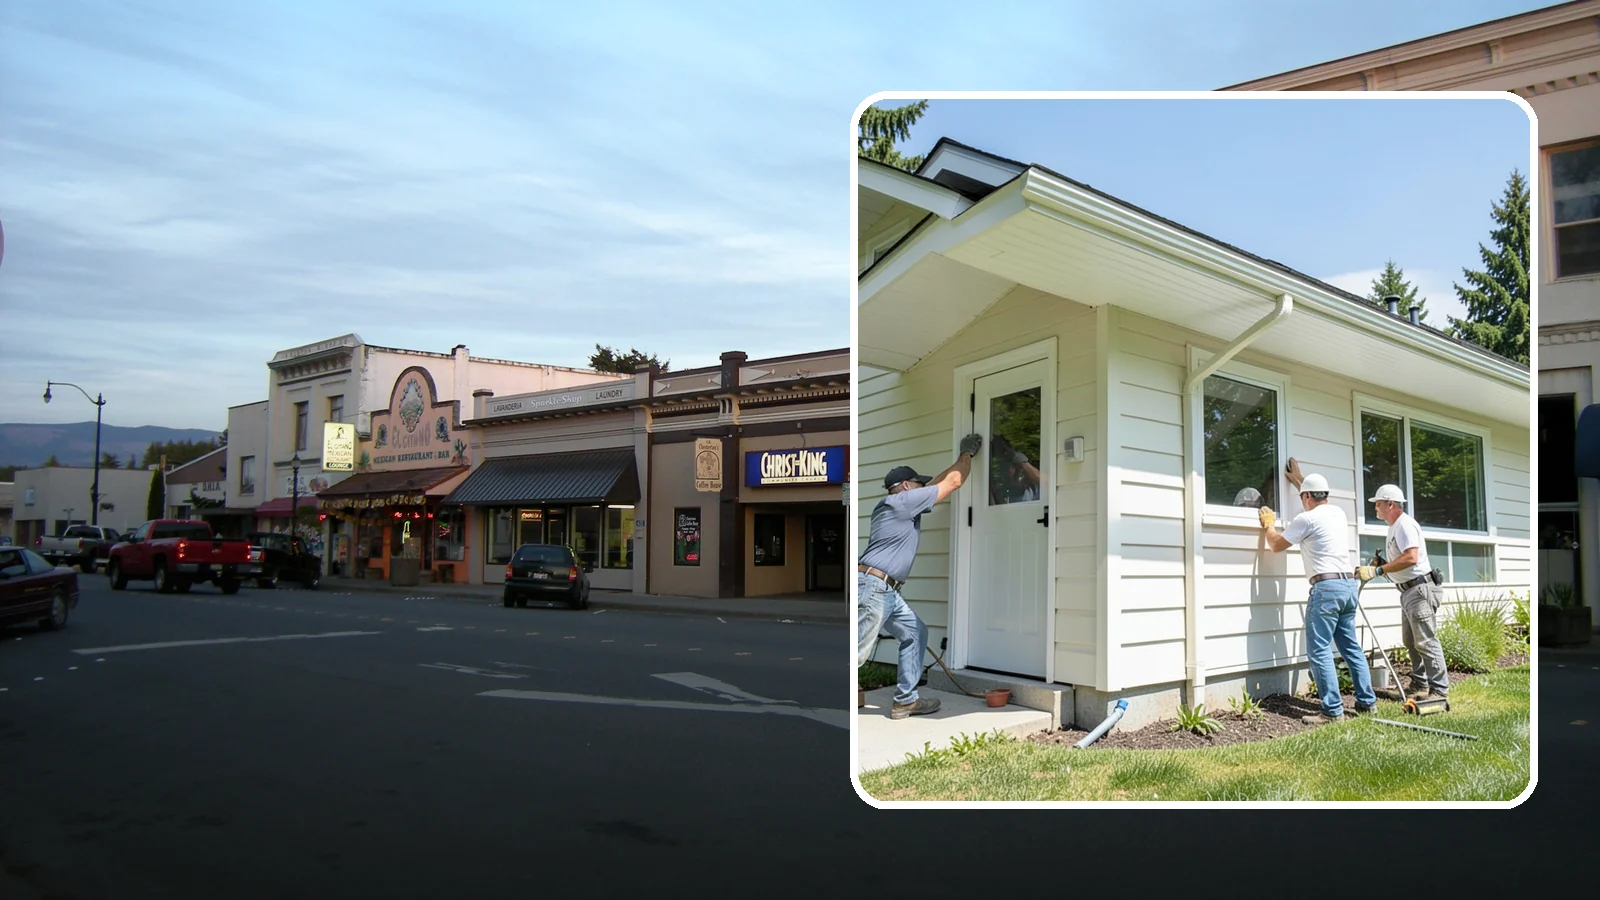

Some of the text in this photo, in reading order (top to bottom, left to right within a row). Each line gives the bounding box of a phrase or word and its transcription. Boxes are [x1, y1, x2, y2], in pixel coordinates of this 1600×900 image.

[493, 389, 624, 412] LAVANDERIA Sparkle Shop LAUNDRY
[373, 450, 450, 464] MEXICAN RESTAURANT BAR
[761, 450, 827, 478] CHRIST KING
[696, 480, 722, 489] Coffee House
